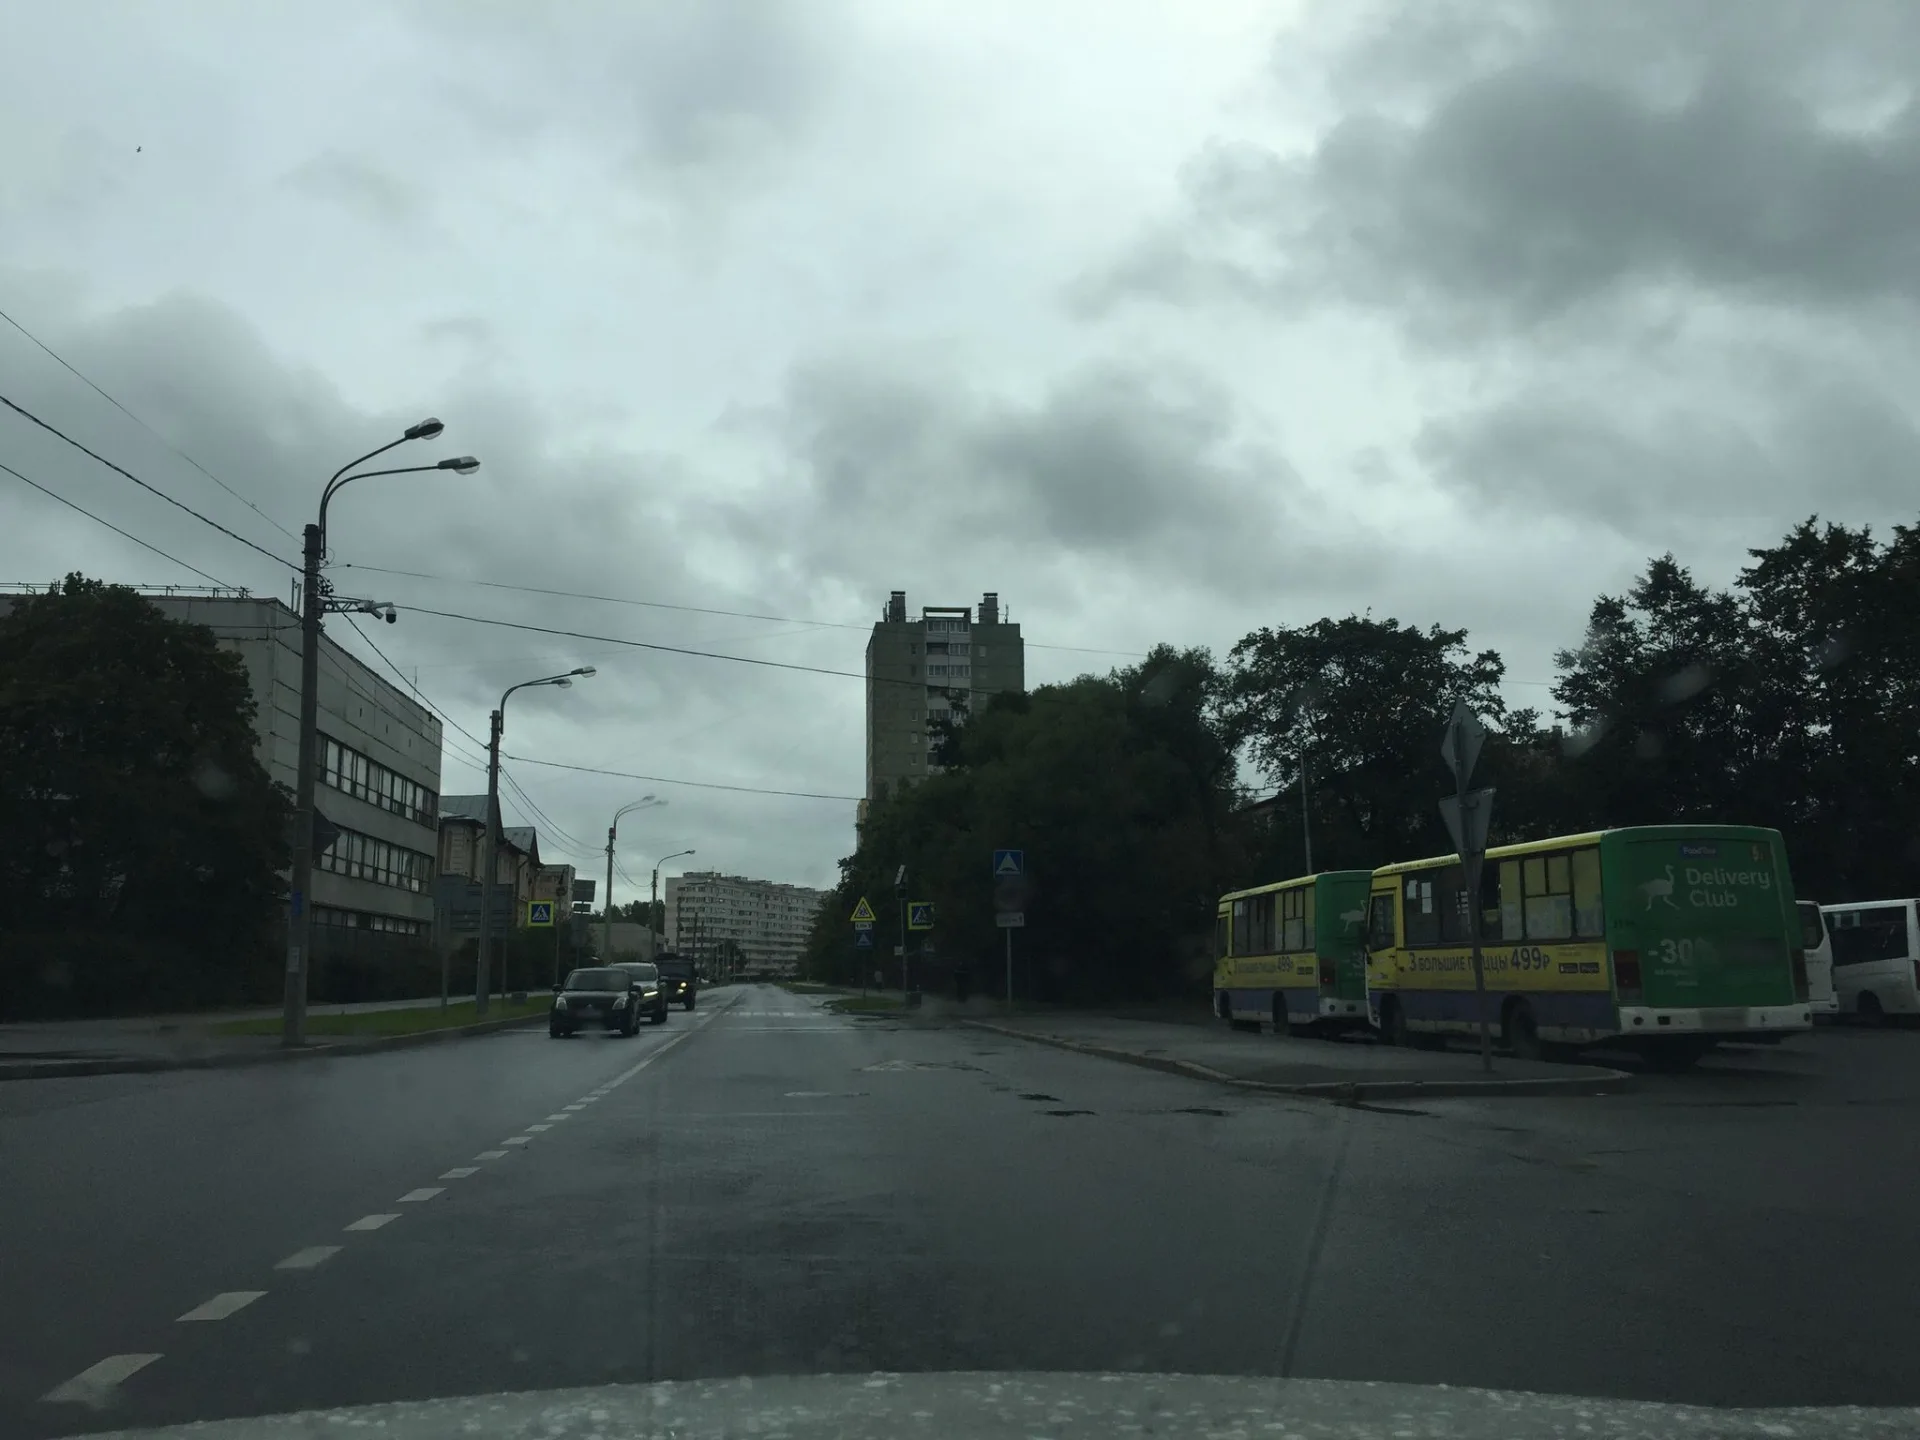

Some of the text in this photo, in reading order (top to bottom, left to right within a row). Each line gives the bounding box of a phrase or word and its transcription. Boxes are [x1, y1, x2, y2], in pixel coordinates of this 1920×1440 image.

[1685, 867, 1770, 890] Delivery
[1689, 888, 1738, 908] Club
[1408, 952, 1417, 971] 3
[1418, 956, 1467, 972] БОЛЬШИЕ
